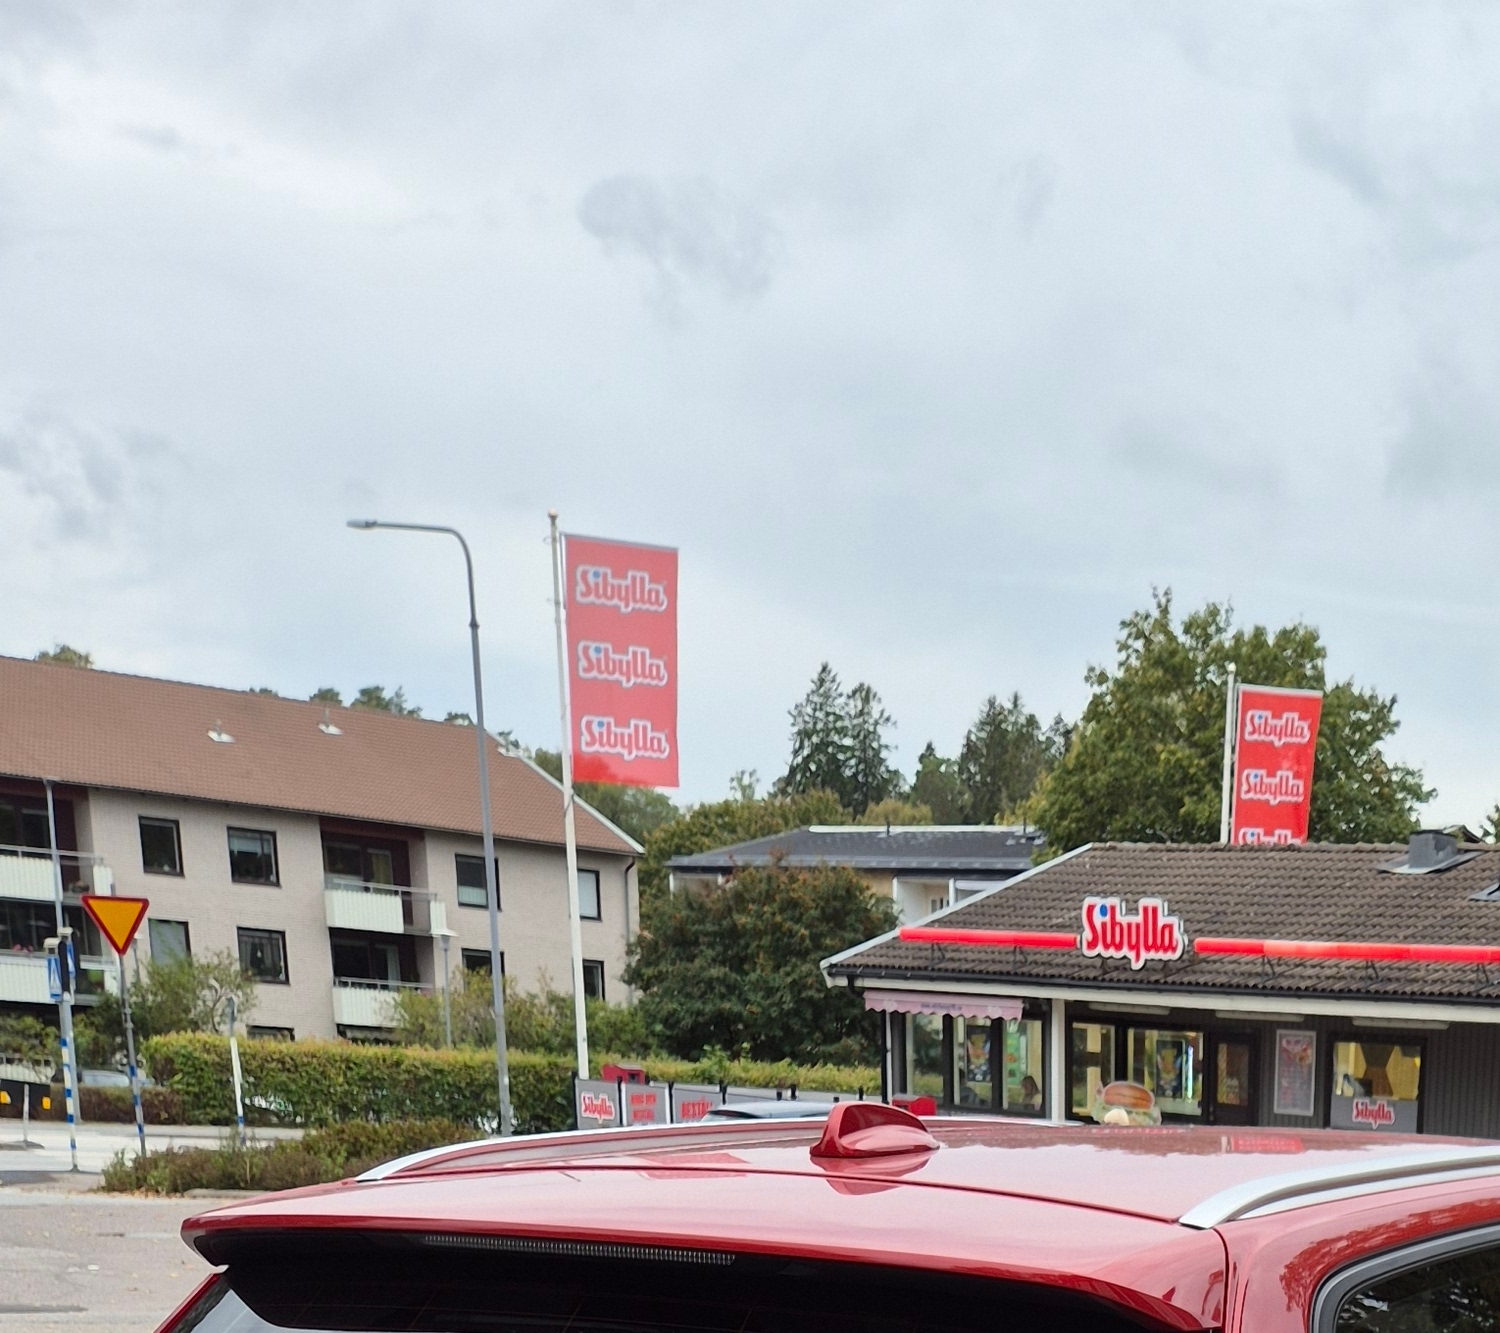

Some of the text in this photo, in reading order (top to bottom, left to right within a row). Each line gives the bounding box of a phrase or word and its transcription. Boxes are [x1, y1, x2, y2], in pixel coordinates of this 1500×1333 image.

[578, 567, 666, 611] Sibylla
[579, 642, 667, 686] Sibylla
[582, 717, 668, 759] Sibylla
[1246, 711, 1308, 745] Sibylla
[1242, 771, 1303, 803] Sibylla
[1084, 899, 1181, 966] Sibylla
[1354, 1101, 1394, 1128] Sibylla
